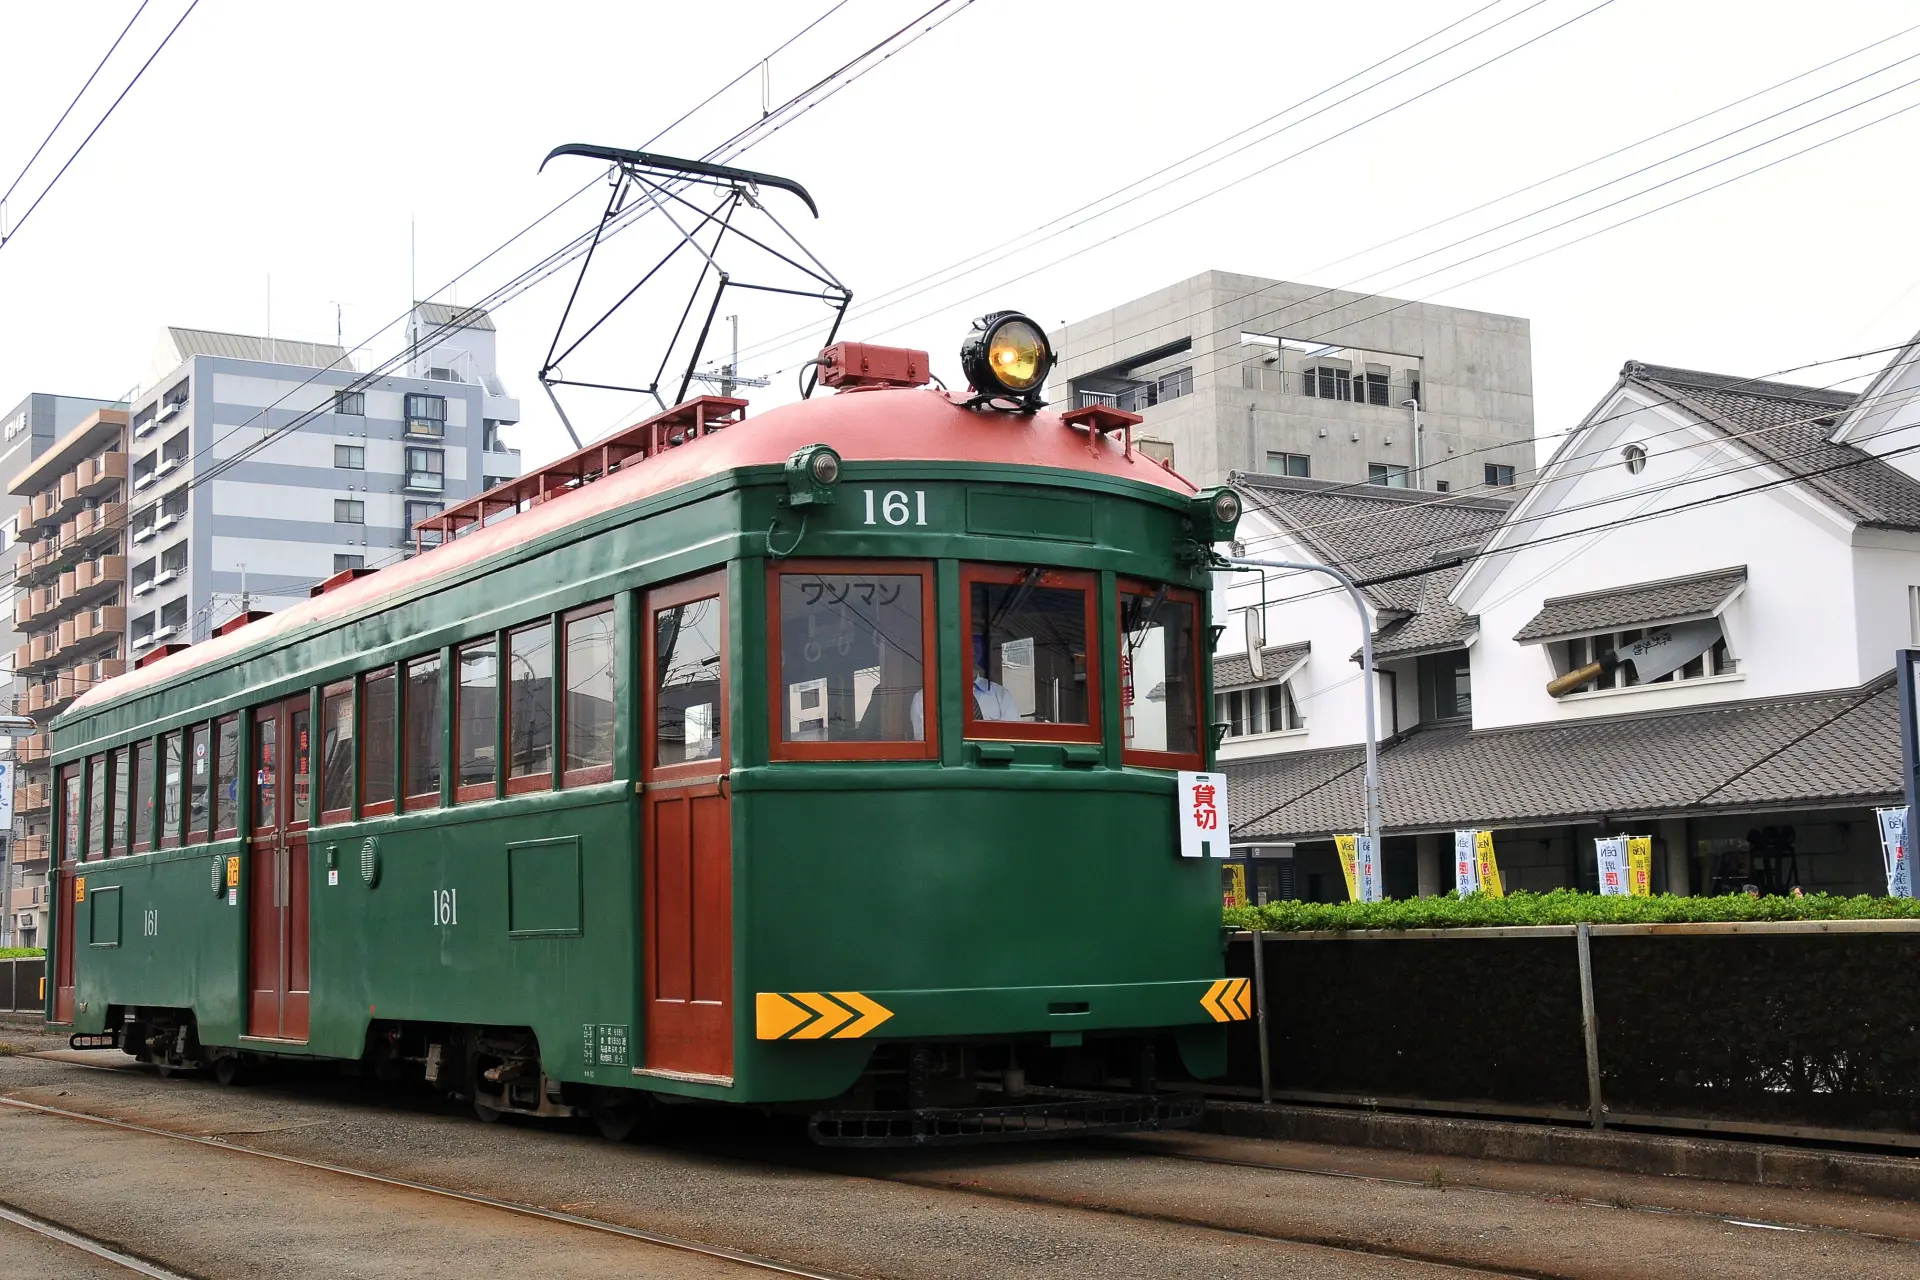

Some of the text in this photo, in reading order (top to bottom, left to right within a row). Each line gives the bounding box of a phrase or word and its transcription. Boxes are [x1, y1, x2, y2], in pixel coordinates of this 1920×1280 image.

[863, 489, 928, 526] 161
[801, 583, 900, 605] ワンマン
[1192, 784, 1217, 830] 貸切
[144, 909, 158, 936] 161
[433, 888, 458, 926] 161
